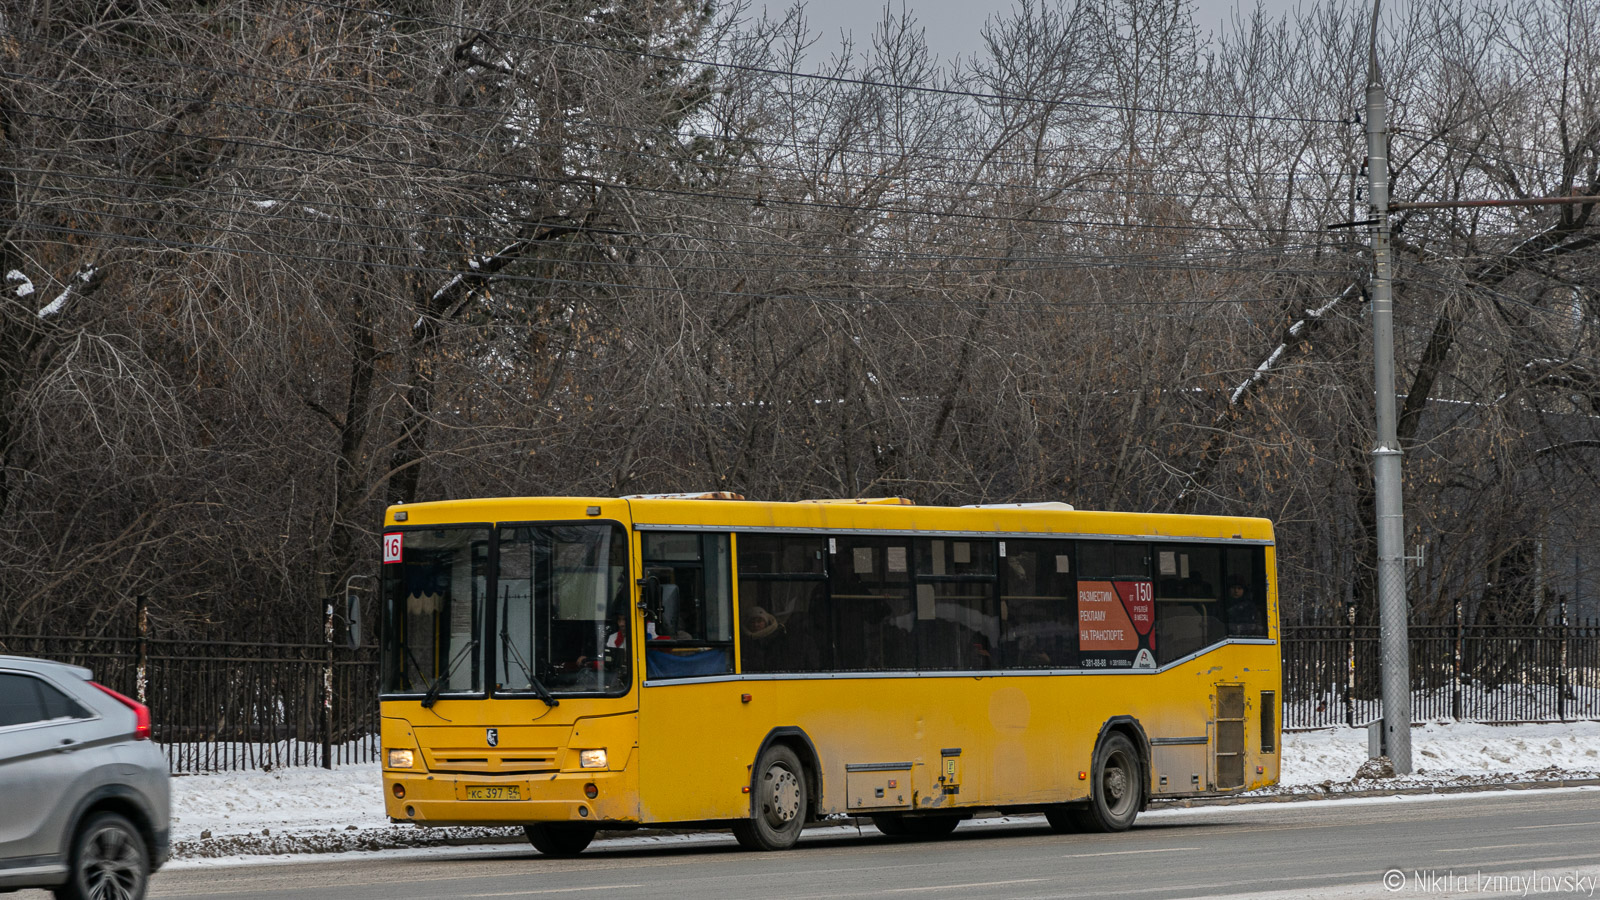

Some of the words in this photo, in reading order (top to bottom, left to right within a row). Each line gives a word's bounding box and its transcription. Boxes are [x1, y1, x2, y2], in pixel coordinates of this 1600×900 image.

[385, 538, 400, 558] 16
[1079, 591, 1112, 602] РАЗМЕСТИМ
[1135, 583, 1151, 601] 150
[1080, 610, 1106, 622] РЕКЛАМУ
[1081, 629, 1090, 641] НА
[1089, 629, 1124, 641] ТРАНСПОРТЕ
[486, 787, 503, 799] 397
[508, 787, 518, 795] 54
